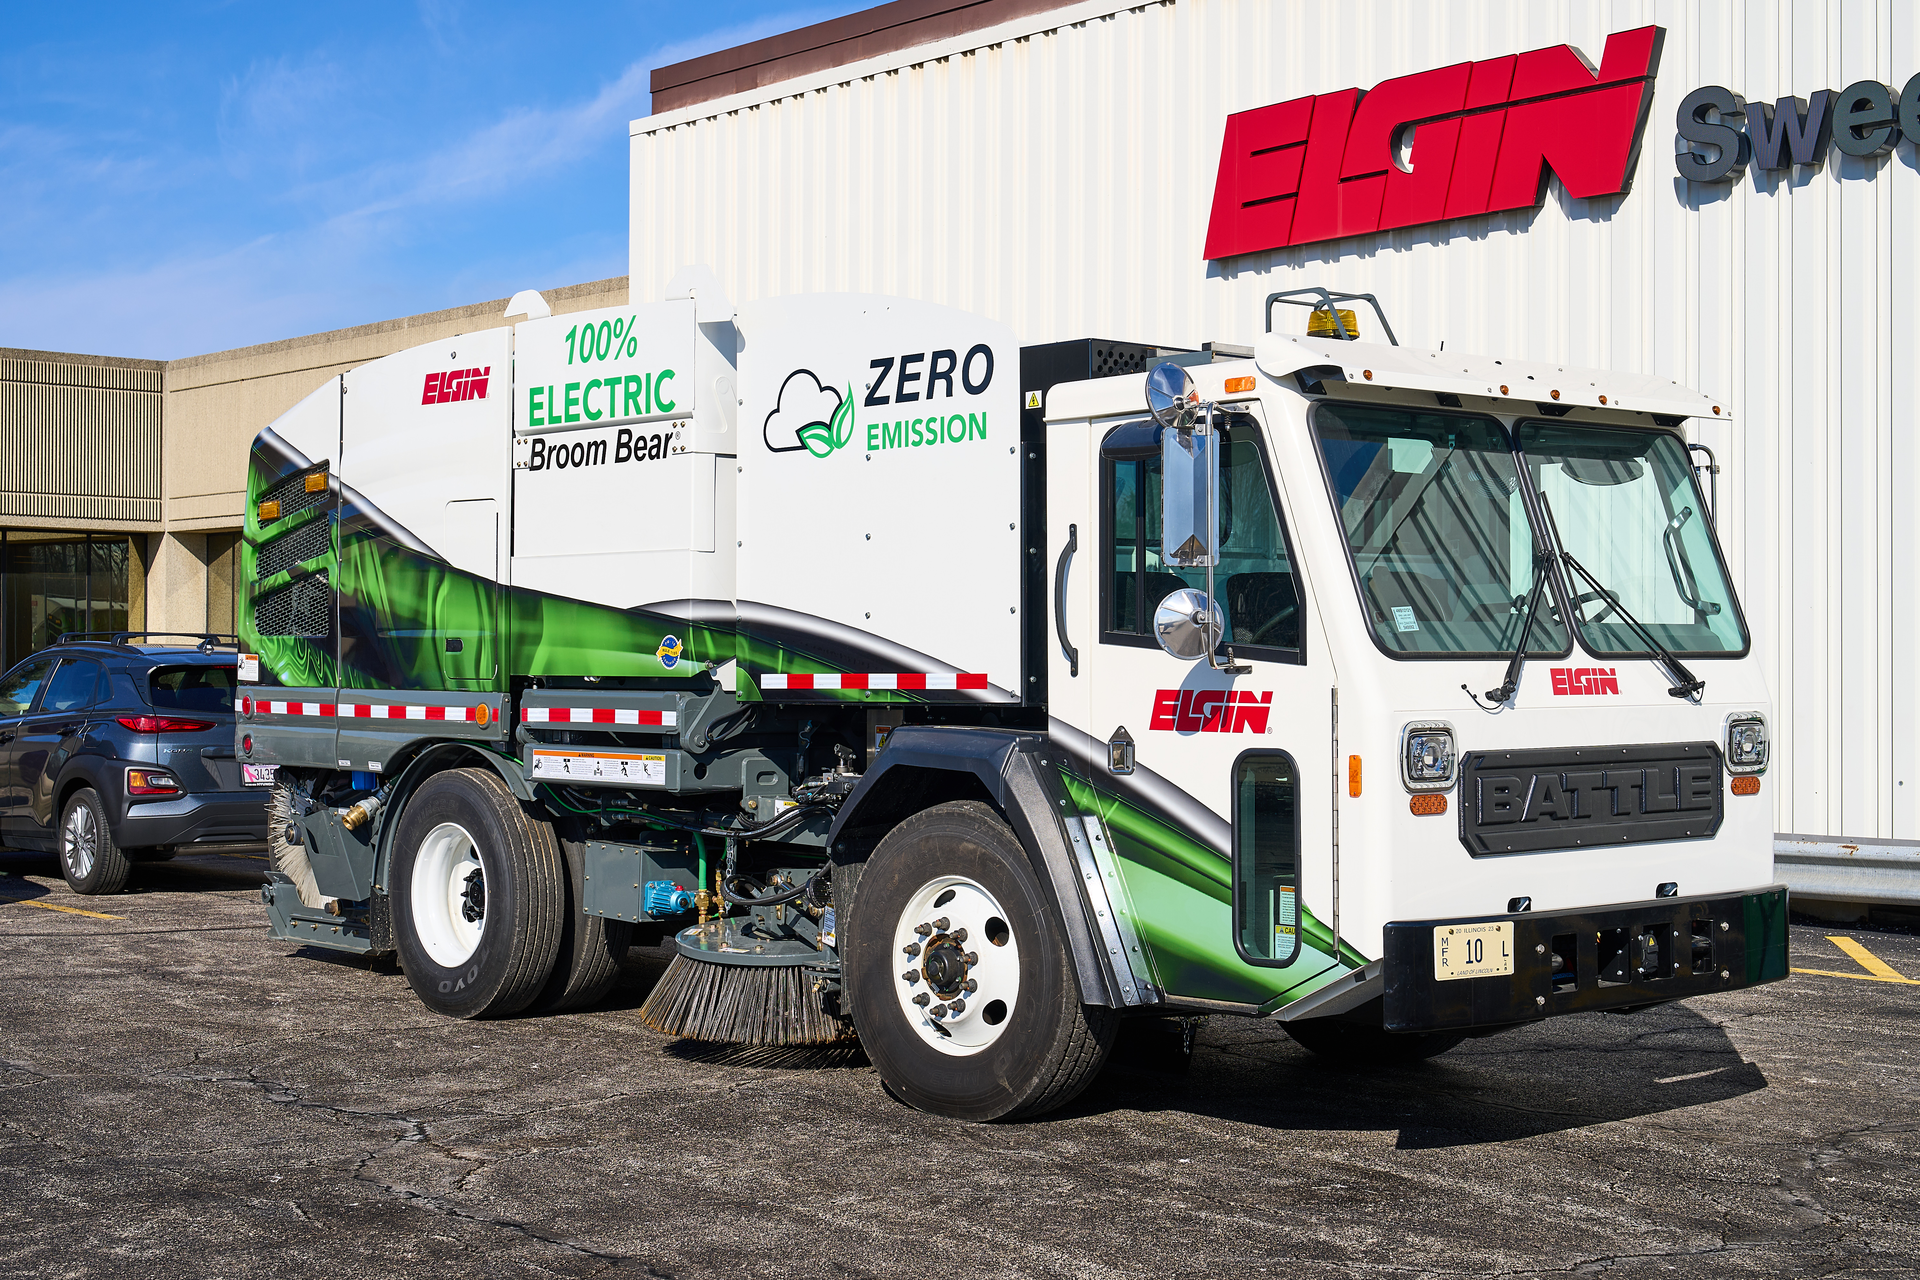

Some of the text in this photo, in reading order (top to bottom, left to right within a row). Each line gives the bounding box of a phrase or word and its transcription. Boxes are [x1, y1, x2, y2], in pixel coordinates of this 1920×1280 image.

[1203, 24, 1666, 260] ELGIN
[565, 315, 637, 365] 100%
[421, 366, 491, 405] ELGIN
[864, 343, 994, 407] ZERO
[529, 369, 676, 427] ELECTRIC
[867, 411, 987, 451] EMISSION
[529, 437, 607, 471] Broom
[1549, 668, 1619, 695] ELGIN
[1149, 689, 1273, 734] ELGIN
[1476, 766, 1712, 826] BATTLE
[1464, 926, 1486, 934] ILLINOIS
[1466, 938, 1483, 964] 10
[1502, 940, 1509, 957] L
[438, 944, 490, 993] TOYO
